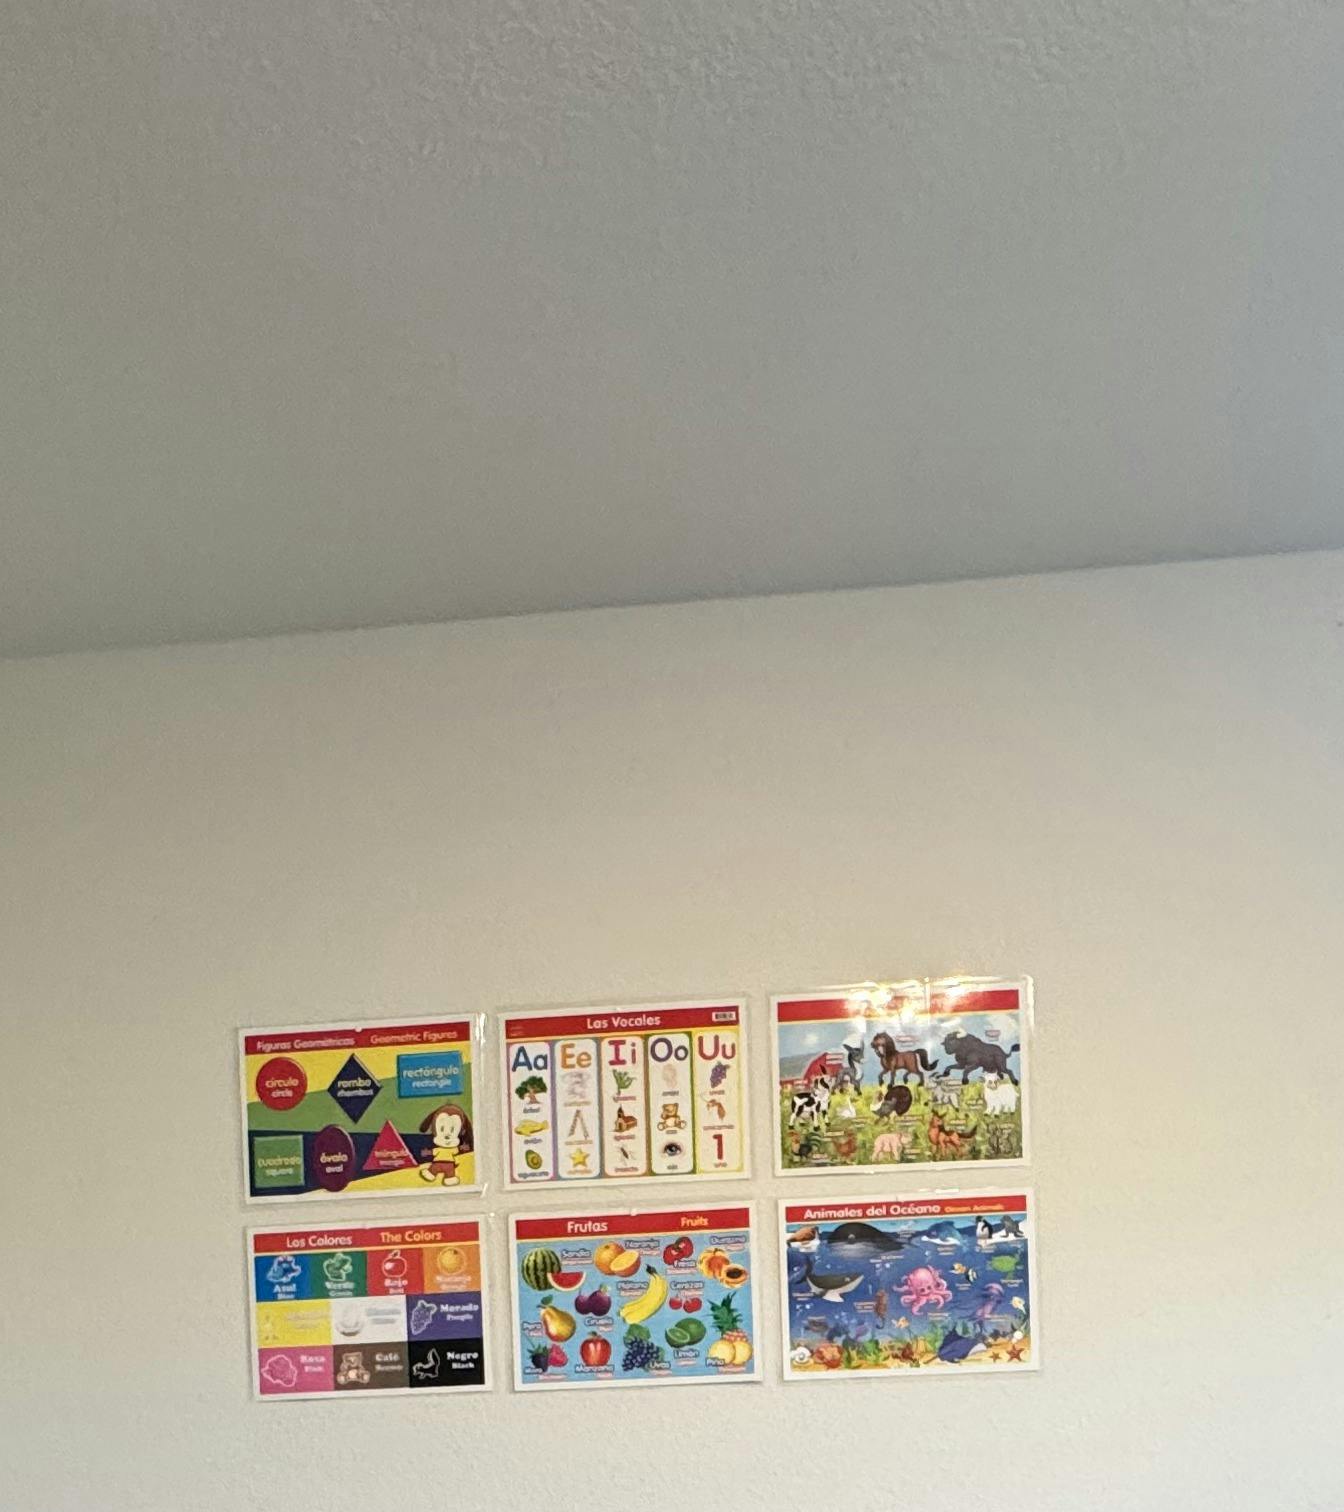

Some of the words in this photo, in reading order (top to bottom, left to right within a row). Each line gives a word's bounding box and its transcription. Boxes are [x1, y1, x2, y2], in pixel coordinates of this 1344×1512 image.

[587, 1017, 608, 1030] Las
[611, 1014, 661, 1028] Vocales
[370, 1032, 420, 1044] Geometric
[423, 1030, 458, 1042] Figures
[257, 1041, 292, 1051] Figuras
[650, 1037, 689, 1063] Oo
[697, 1034, 737, 1061] Uu
[511, 1046, 548, 1072] Aa
[561, 1043, 592, 1069] Ee
[337, 1077, 371, 1087] rombo
[804, 1208, 863, 1219] Animales
[867, 1206, 886, 1216] del
[890, 1203, 940, 1215] Océano
[567, 1221, 608, 1233] Frutas
[681, 1216, 709, 1227] Fruits
[286, 1237, 306, 1249] Los
[309, 1234, 353, 1247] Colores
[380, 1231, 403, 1243] The
[405, 1229, 443, 1242] Colors
[447, 1352, 479, 1362] Negro
